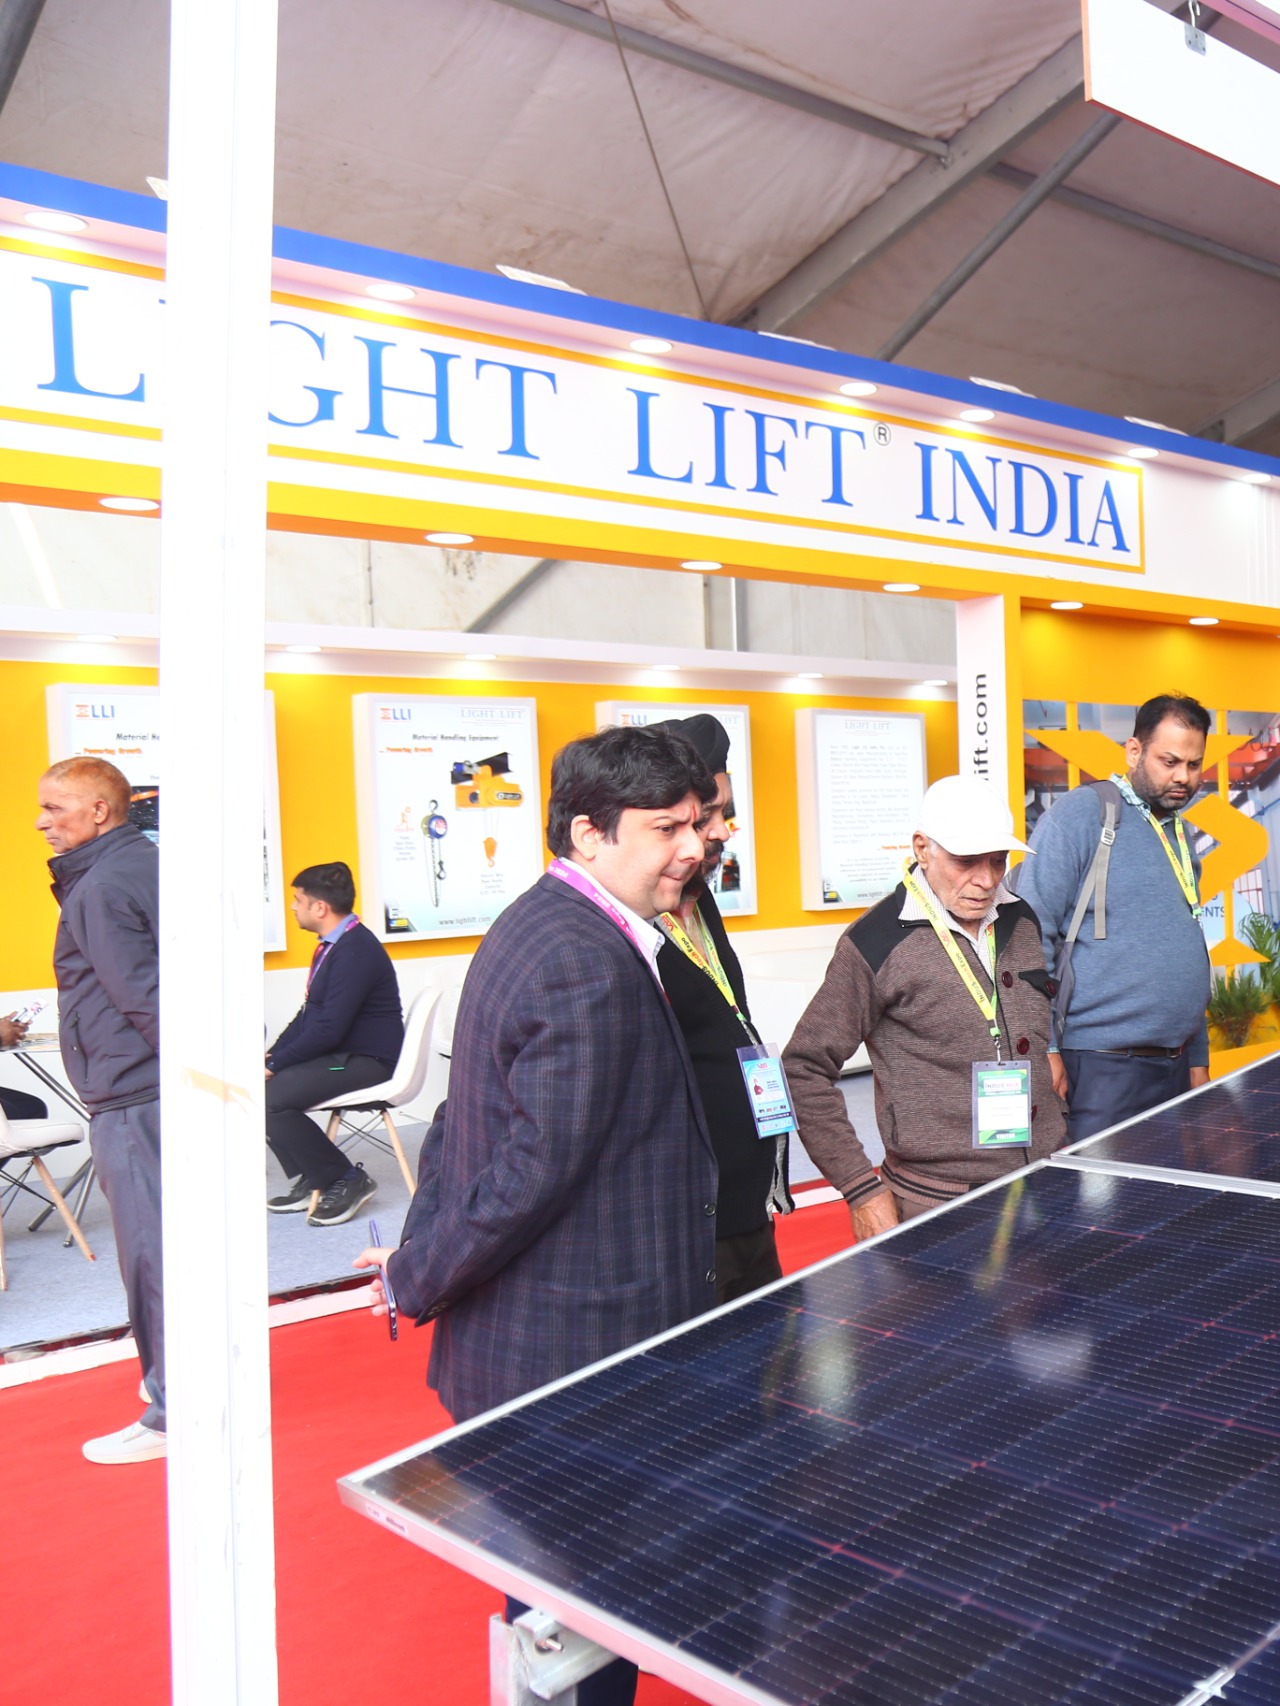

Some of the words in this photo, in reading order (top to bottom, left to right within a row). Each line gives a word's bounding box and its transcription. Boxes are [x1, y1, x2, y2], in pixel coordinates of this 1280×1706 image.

[31, 276, 557, 462] LGHT
[626, 386, 866, 508] LIFT
[914, 441, 1131, 553] INDIA
[460, 709, 494, 719] LIGHT
[500, 710, 524, 719] LIFT
[973, 673, 989, 781] ift.com
